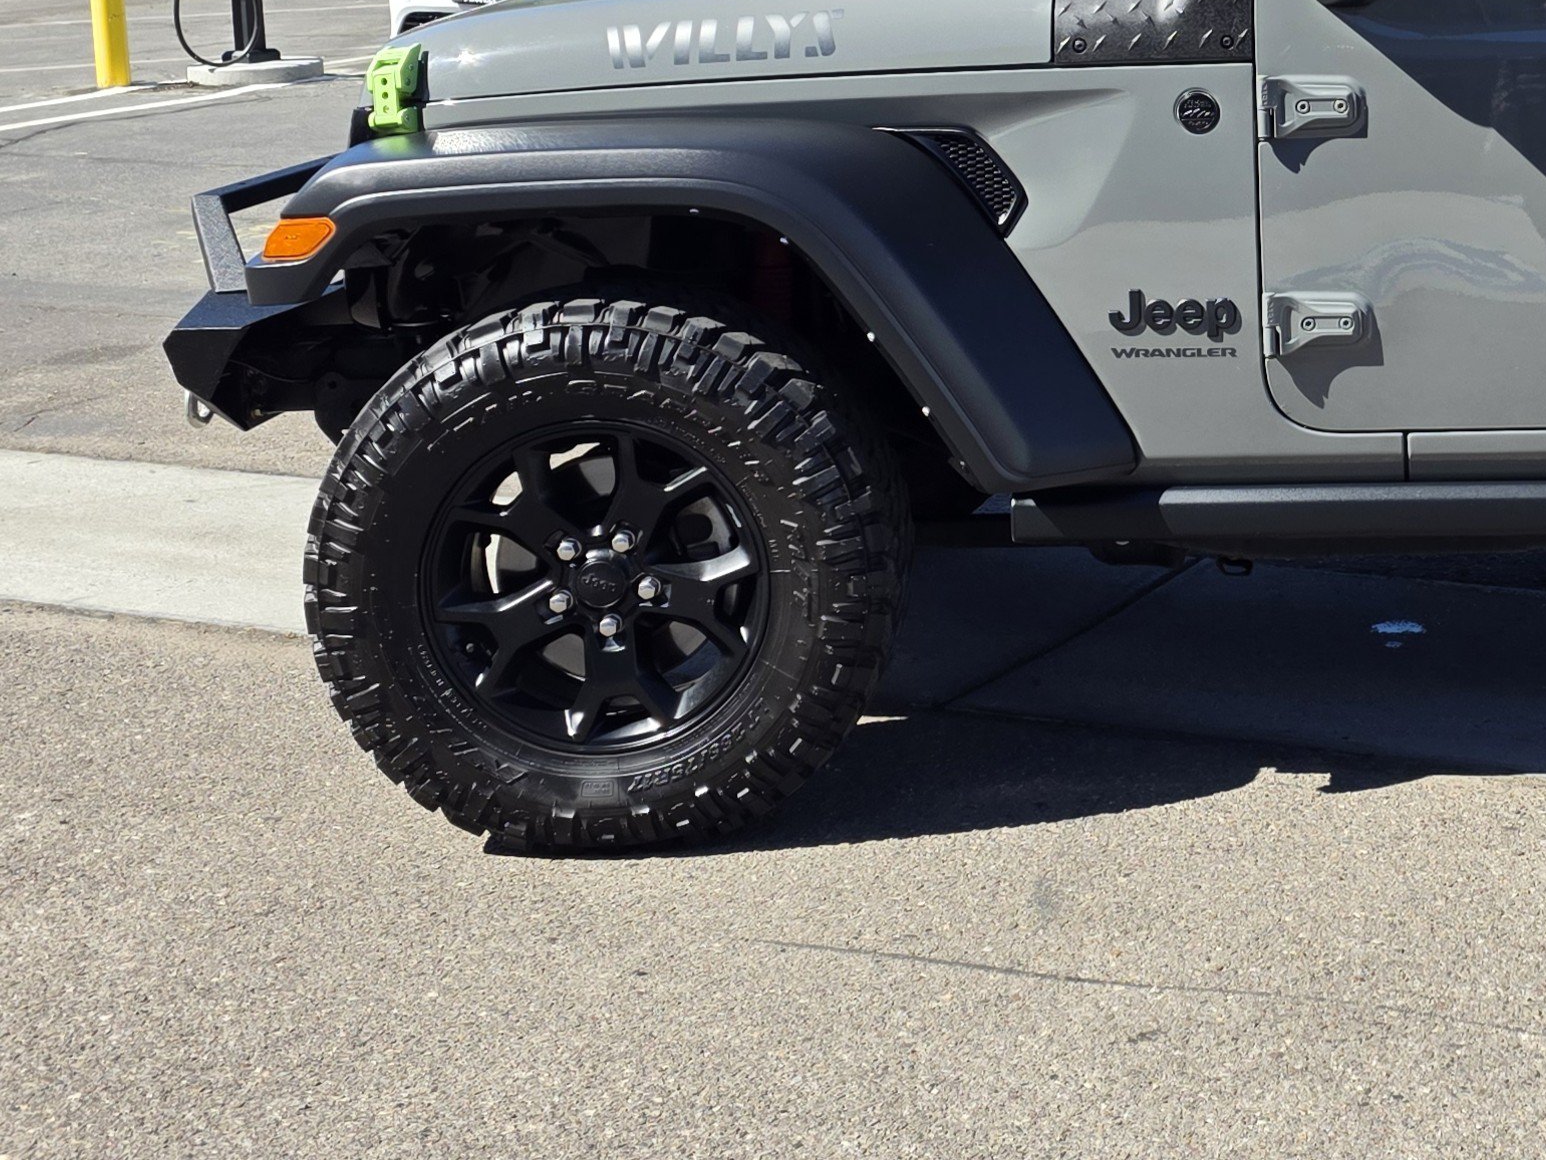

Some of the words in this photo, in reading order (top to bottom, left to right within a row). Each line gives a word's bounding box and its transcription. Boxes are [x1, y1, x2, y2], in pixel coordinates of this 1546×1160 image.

[606, 8, 845, 70] WILLYS
[1108, 288, 1238, 340] Jeep
[1110, 346, 1238, 359] WRANGLER
